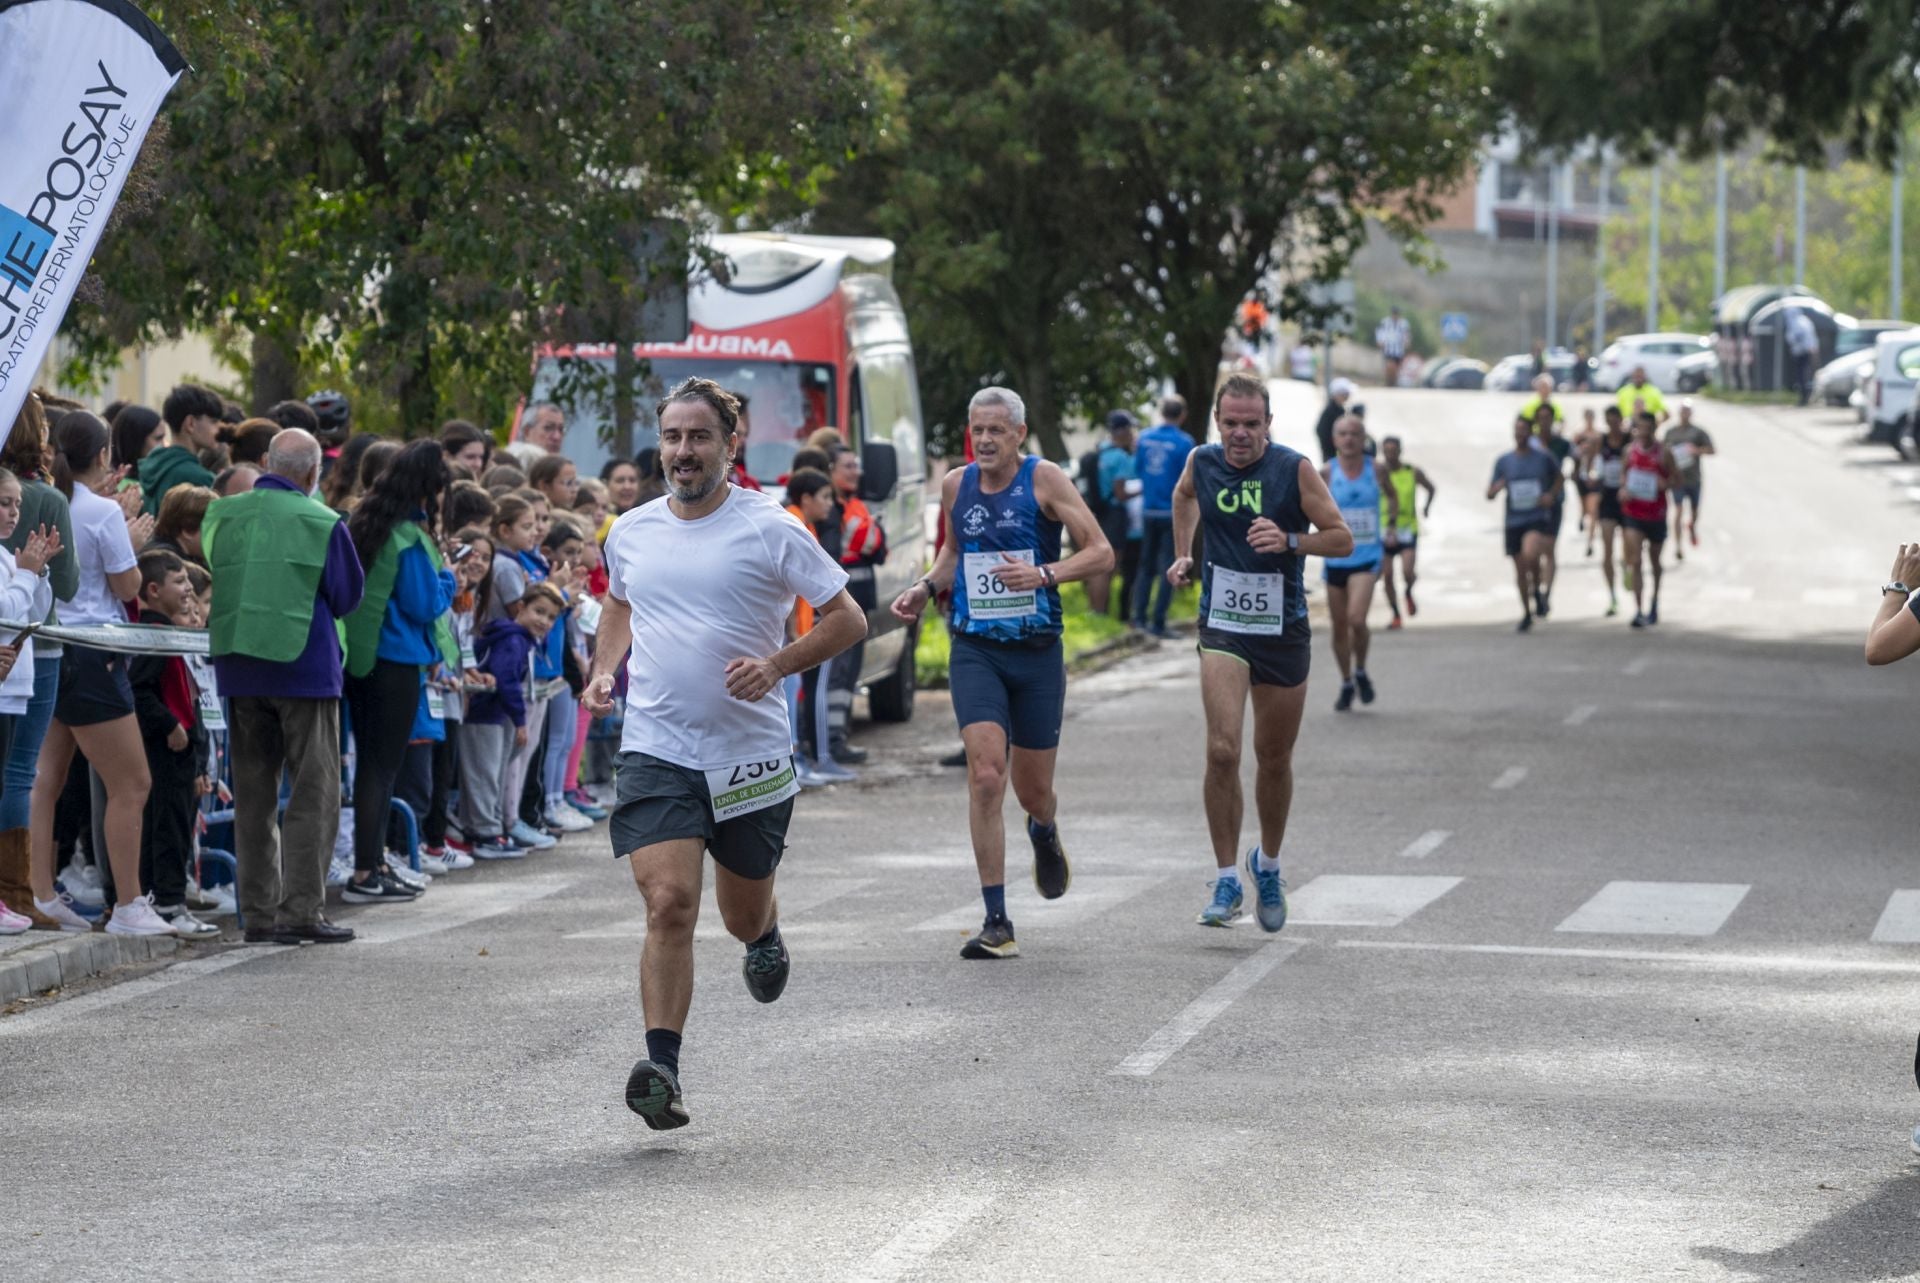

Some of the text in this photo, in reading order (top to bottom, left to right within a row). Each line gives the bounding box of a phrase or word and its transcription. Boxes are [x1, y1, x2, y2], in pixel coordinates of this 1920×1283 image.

[26, 58, 129, 237] POSAY
[39, 113, 137, 296] DERMATOLOGIQUE
[1242, 480, 1262, 489] RUN
[977, 573, 1006, 595] 36
[1224, 588, 1268, 612] 365
[715, 772, 792, 807] JUNTA DE EXTREMADURA
